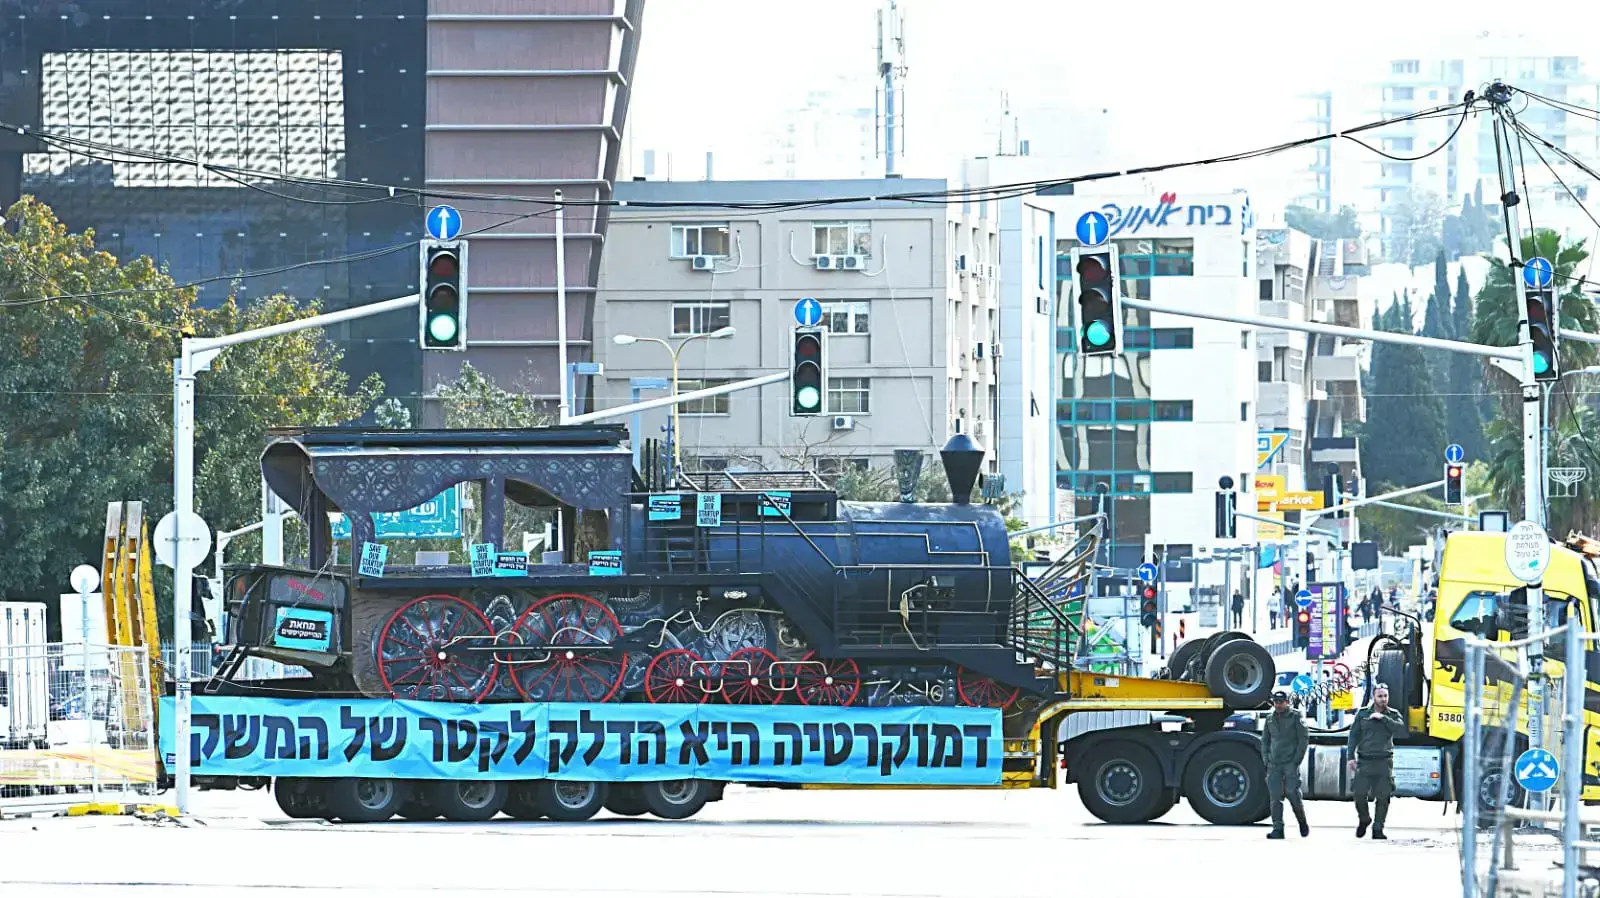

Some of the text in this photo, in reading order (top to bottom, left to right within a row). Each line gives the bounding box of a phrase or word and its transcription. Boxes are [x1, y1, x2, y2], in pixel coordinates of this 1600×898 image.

[1186, 205, 1232, 226] בית
[703, 495, 715, 503] SAVE
[703, 502, 714, 510] OUR
[699, 509, 720, 518] STARTUP
[700, 517, 718, 525] NATION
[368, 544, 382, 553] SAVE
[476, 545, 489, 553] SAVE
[368, 552, 379, 561] OUR
[477, 552, 488, 560] OUR
[362, 558, 384, 569] STARTUP
[473, 559, 494, 568] STARTUP
[362, 566, 381, 576] NATION
[474, 567, 493, 575] NATION
[289, 620, 316, 631] מחאת
[1438, 712, 1465, 722] 5380
[190, 705, 992, 776] דמוקרטיה היא הדלק לקטר של המשק
